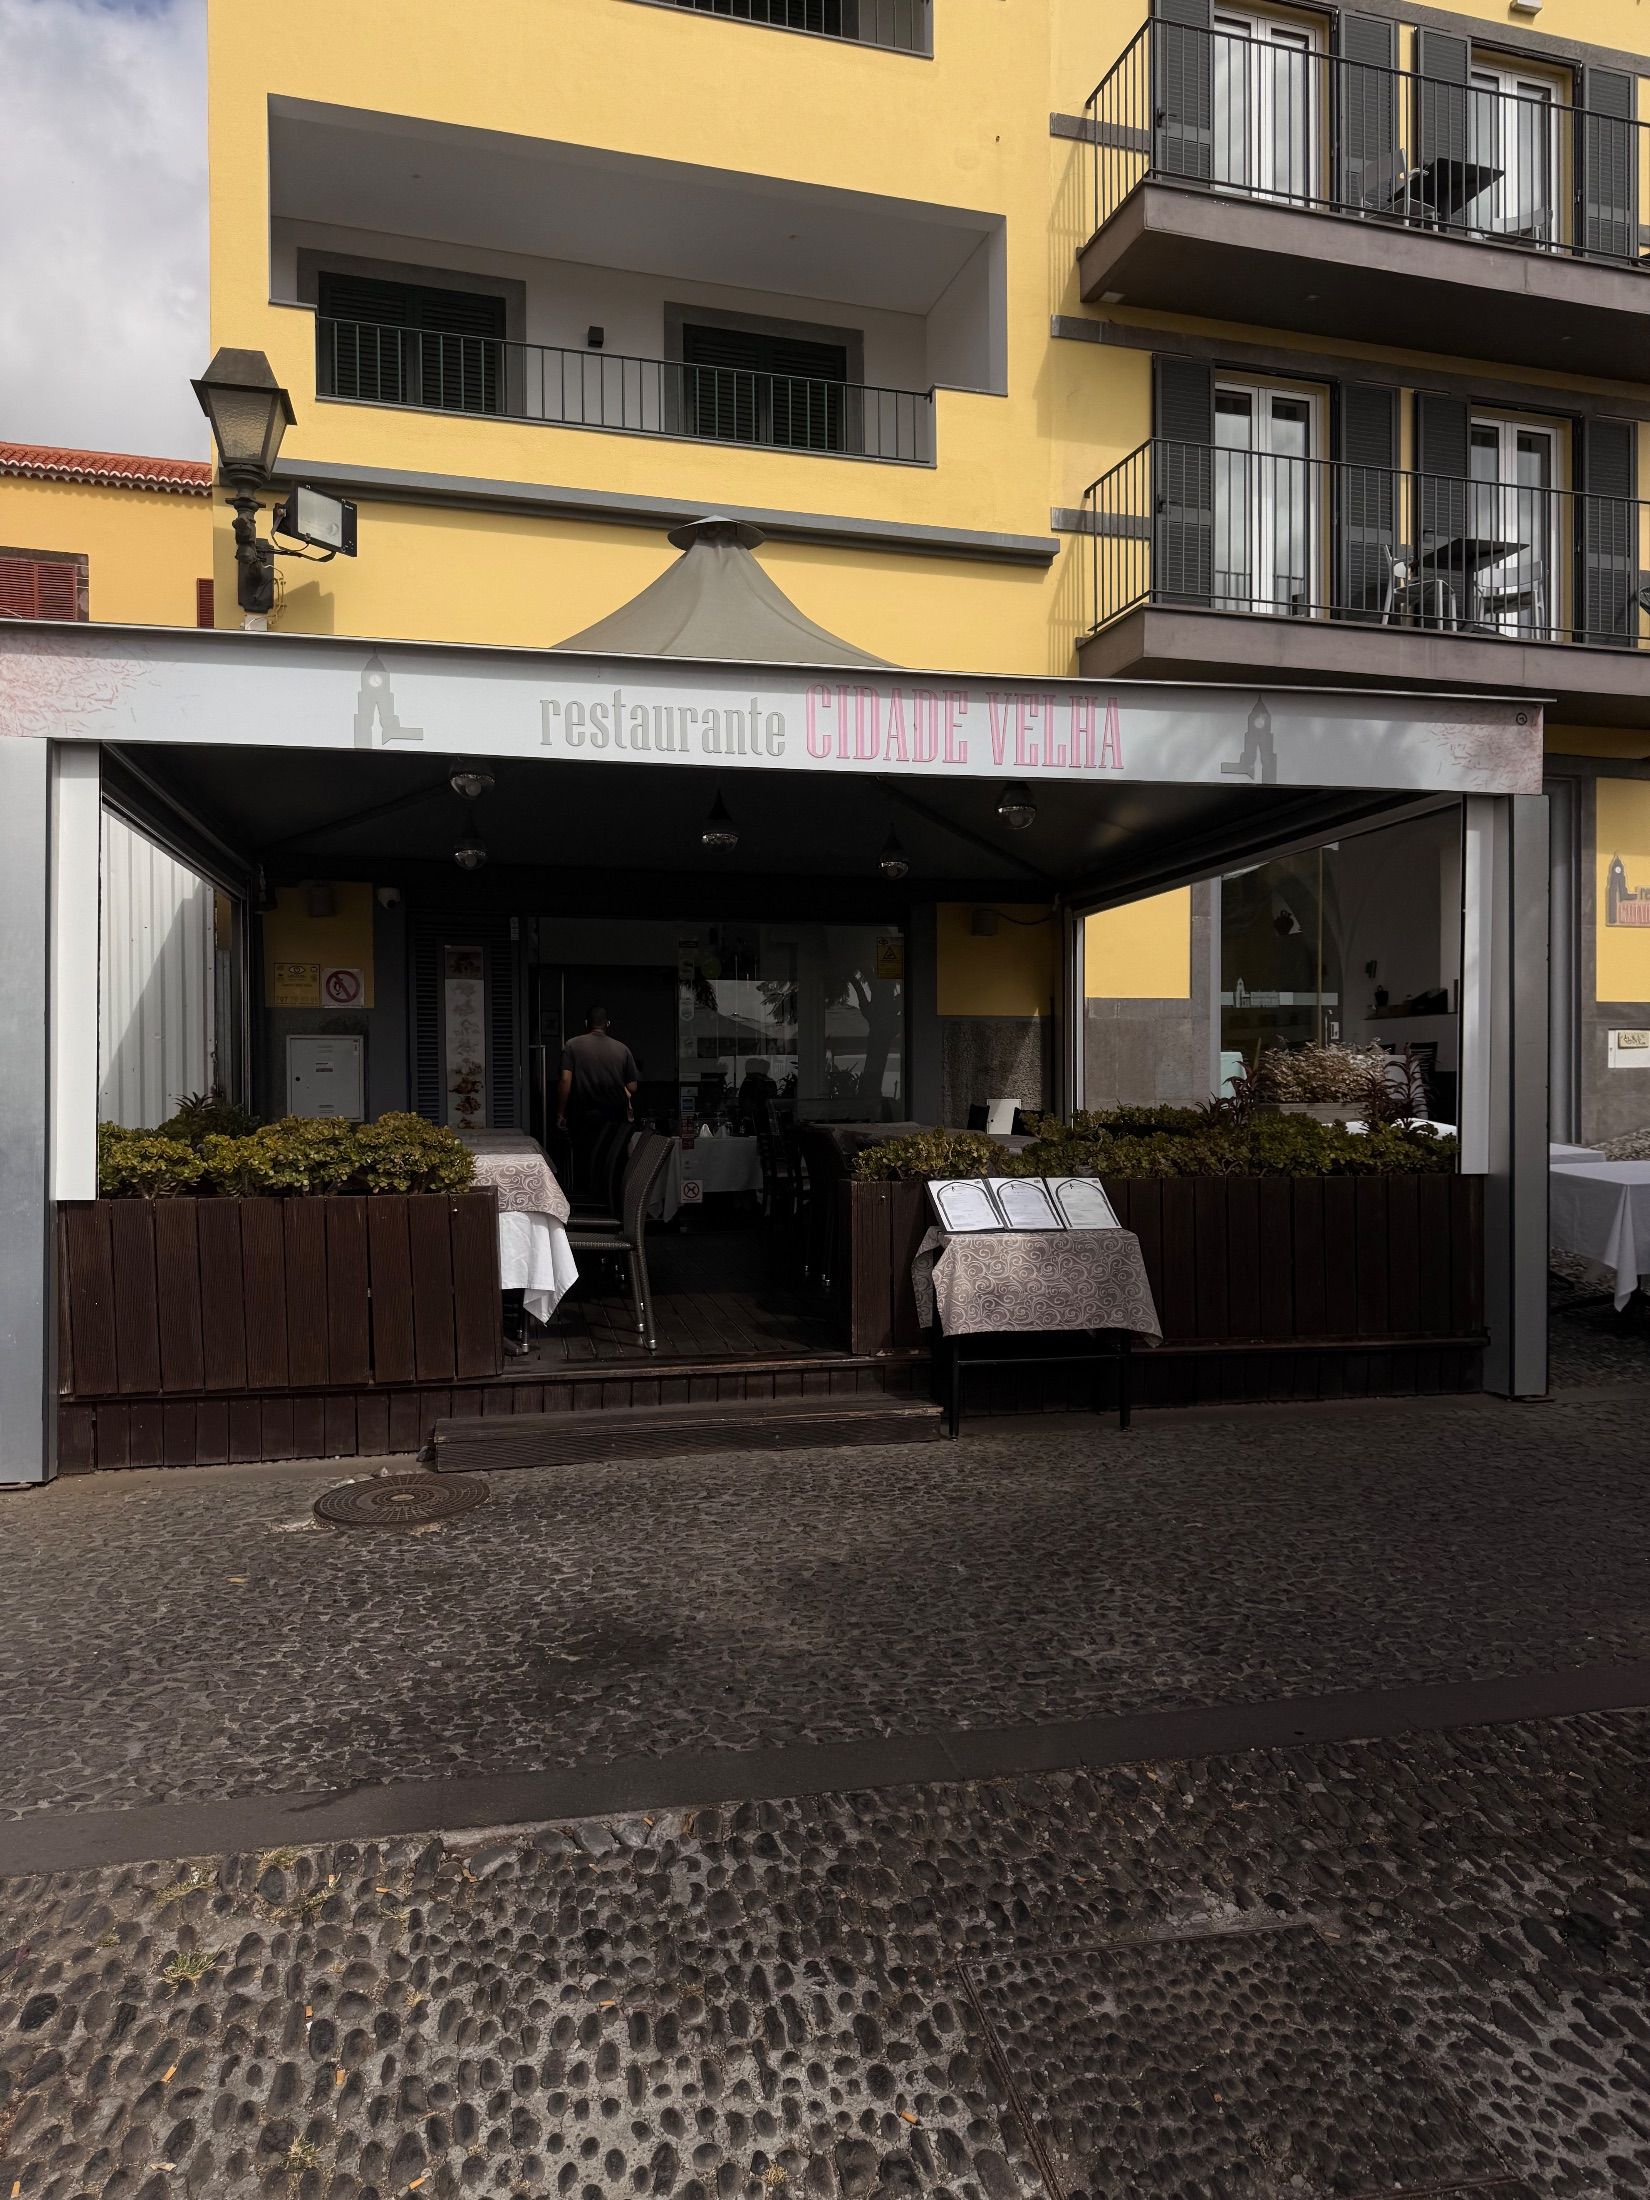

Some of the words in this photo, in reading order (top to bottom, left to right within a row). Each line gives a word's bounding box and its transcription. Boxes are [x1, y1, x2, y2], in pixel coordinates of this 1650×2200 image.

[540, 688, 786, 757] restaurante
[805, 682, 969, 763] CIDADE
[985, 691, 1124, 769] VELHA
